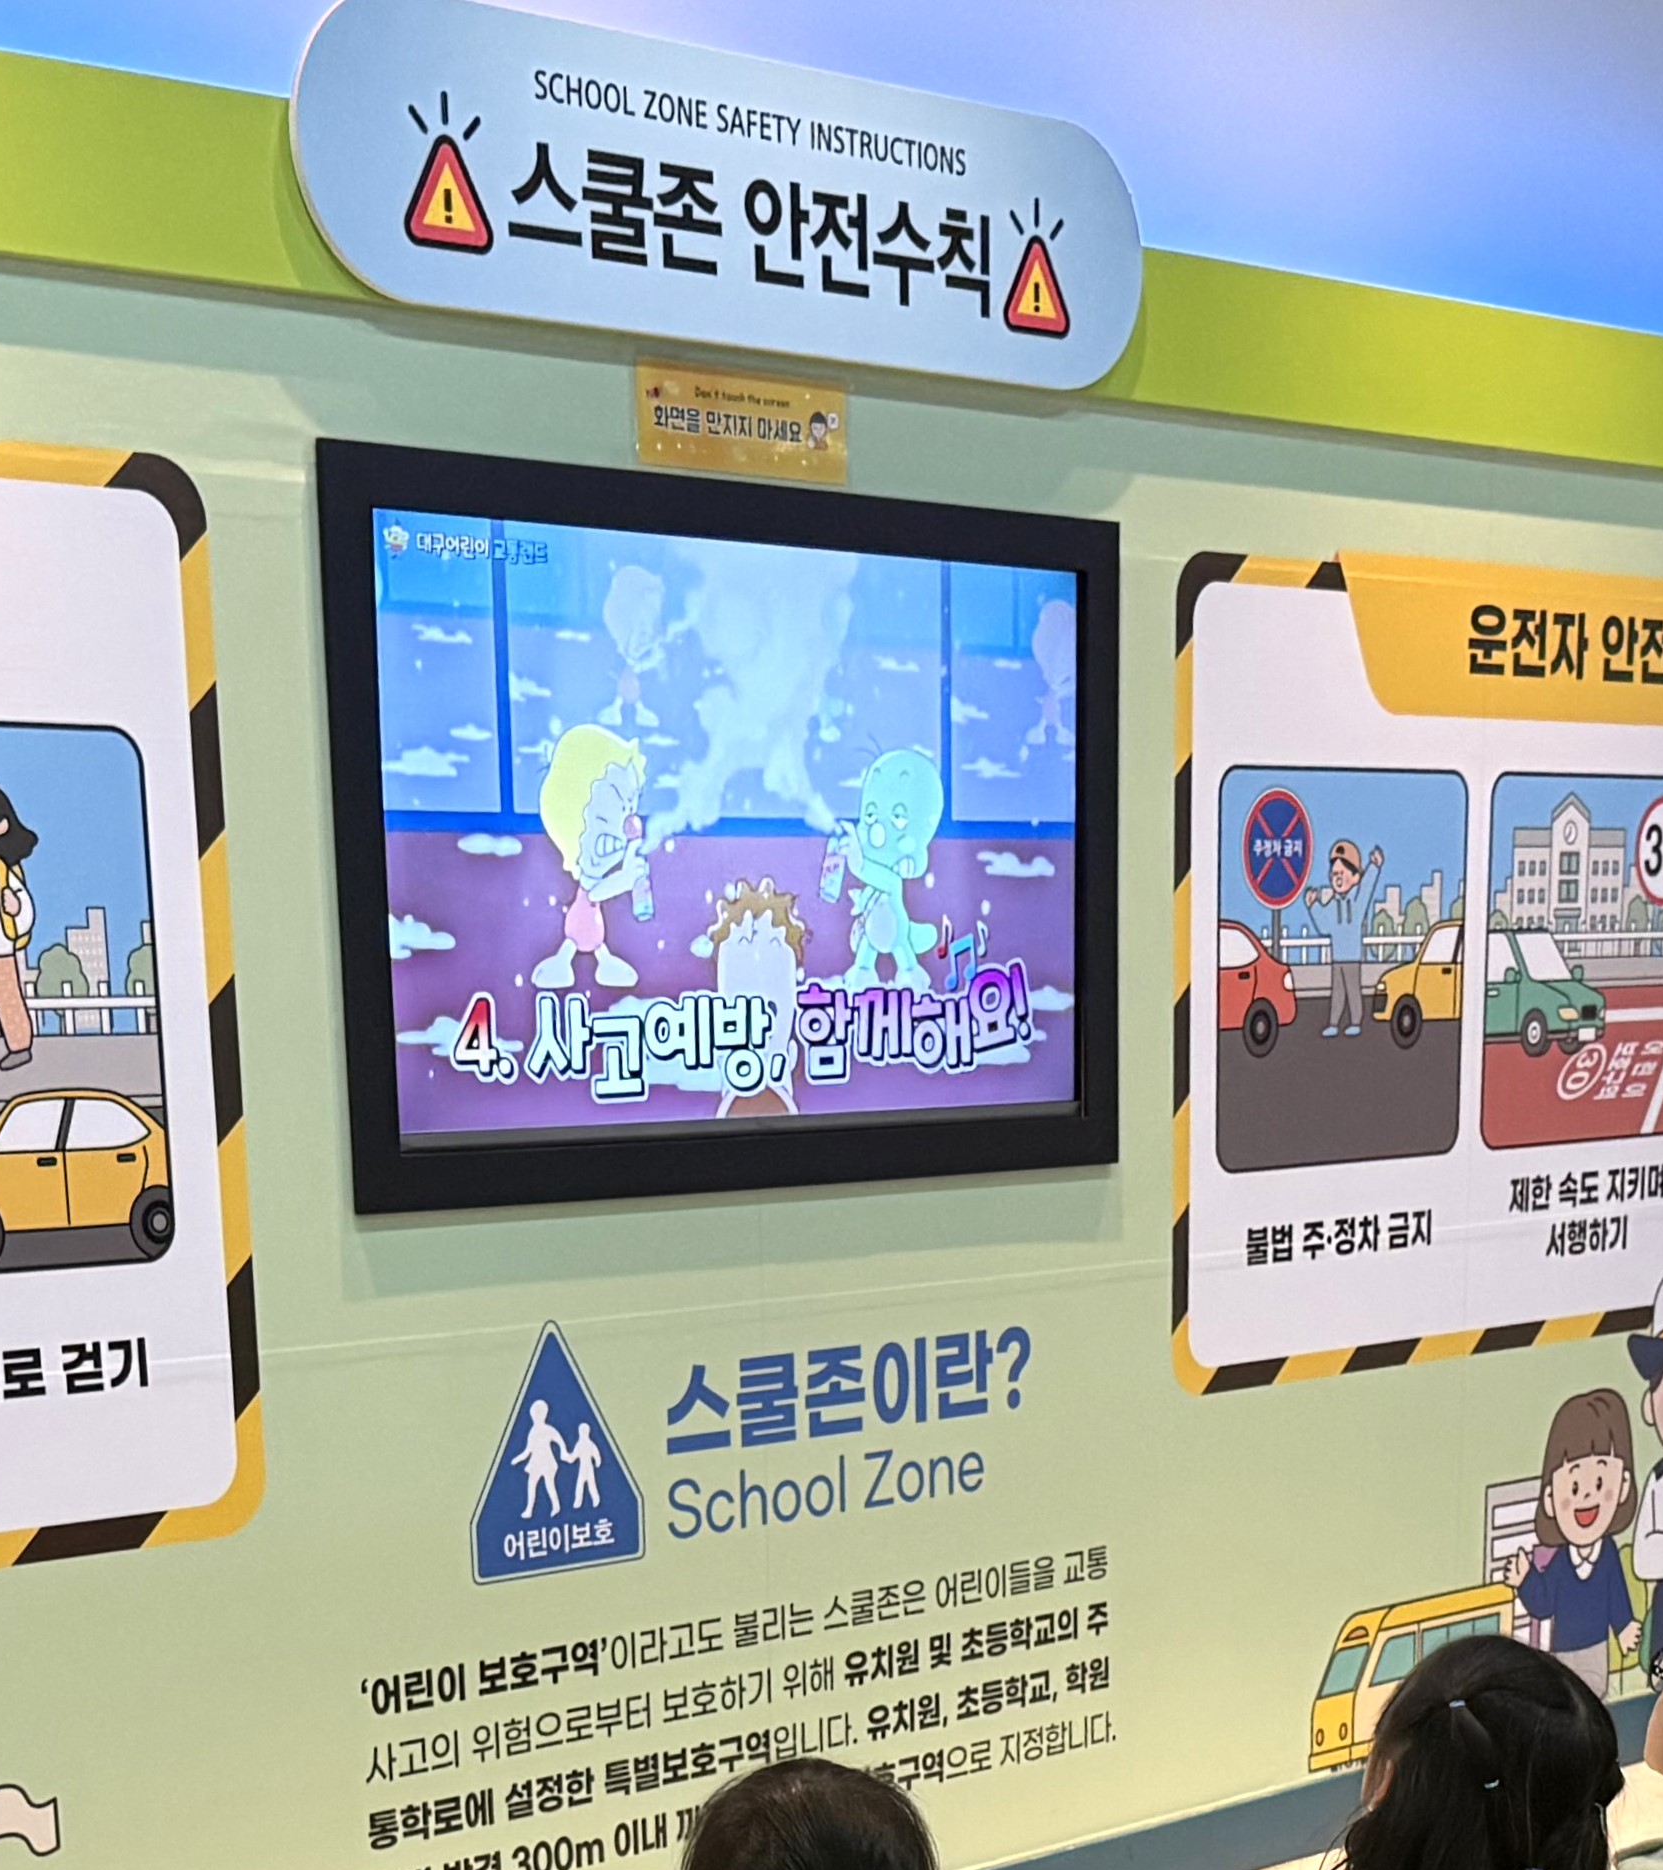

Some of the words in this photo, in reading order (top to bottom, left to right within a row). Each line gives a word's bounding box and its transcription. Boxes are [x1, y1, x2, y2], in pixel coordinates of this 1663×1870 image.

[533, 69, 636, 119] SCHOOL
[643, 89, 708, 130] ZONE
[716, 105, 801, 149] SAFETY
[811, 119, 967, 177] INSTRUCTIONS
[508, 142, 723, 277] 스쿨존
[744, 176, 991, 318] 안전수칙
[654, 405, 700, 434] 화면을
[706, 411, 753, 438] 만지지
[758, 417, 802, 443] 마세요
[1468, 603, 1588, 681] 운전자
[456, 997, 513, 1077] 4.
[528, 994, 785, 1098] 사고예방,
[797, 963, 1030, 1080] 함께해요!
[1245, 1221, 1294, 1267] 불법
[1389, 1210, 1433, 1249] 금지
[1509, 1173, 1552, 1215] 제한
[1558, 1169, 1600, 1208] 속도
[1545, 1215, 1629, 1259] 서행하기
[61, 1336, 150, 1396] 걷기
[665, 1326, 1033, 1456] 스쿨존이란?
[503, 1519, 616, 1560] 어린이보호
[667, 1455, 848, 1540] School
[864, 1447, 986, 1509] Zone
[733, 1602, 816, 1650] 불리는
[823, 1579, 927, 1632] 스쿨존은
[935, 1554, 1055, 1610] 어린이들을
[1063, 1544, 1109, 1585] 교통
[365, 1729, 460, 1786] 사고의
[471, 1692, 652, 1764] 위험으로부터
[662, 1667, 773, 1724] 보호하기
[782, 1655, 835, 1700] 위해
[844, 1638, 921, 1688] 유치원
[928, 1632, 953, 1671] 및
[960, 1606, 1080, 1664] 초등학교의
[1086, 1601, 1109, 1637] 주
[368, 1787, 496, 1851] 통학로에
[505, 1766, 595, 1822] 설정한
[603, 1712, 859, 1797] 특별보호구역입니다.
[866, 1692, 949, 1742] 유치원,
[956, 1669, 1059, 1723] 초등학교,
[1065, 1655, 1111, 1695] 학원
[612, 1812, 668, 1859] 이내
[999, 1711, 1117, 1768] 지정합니다.
